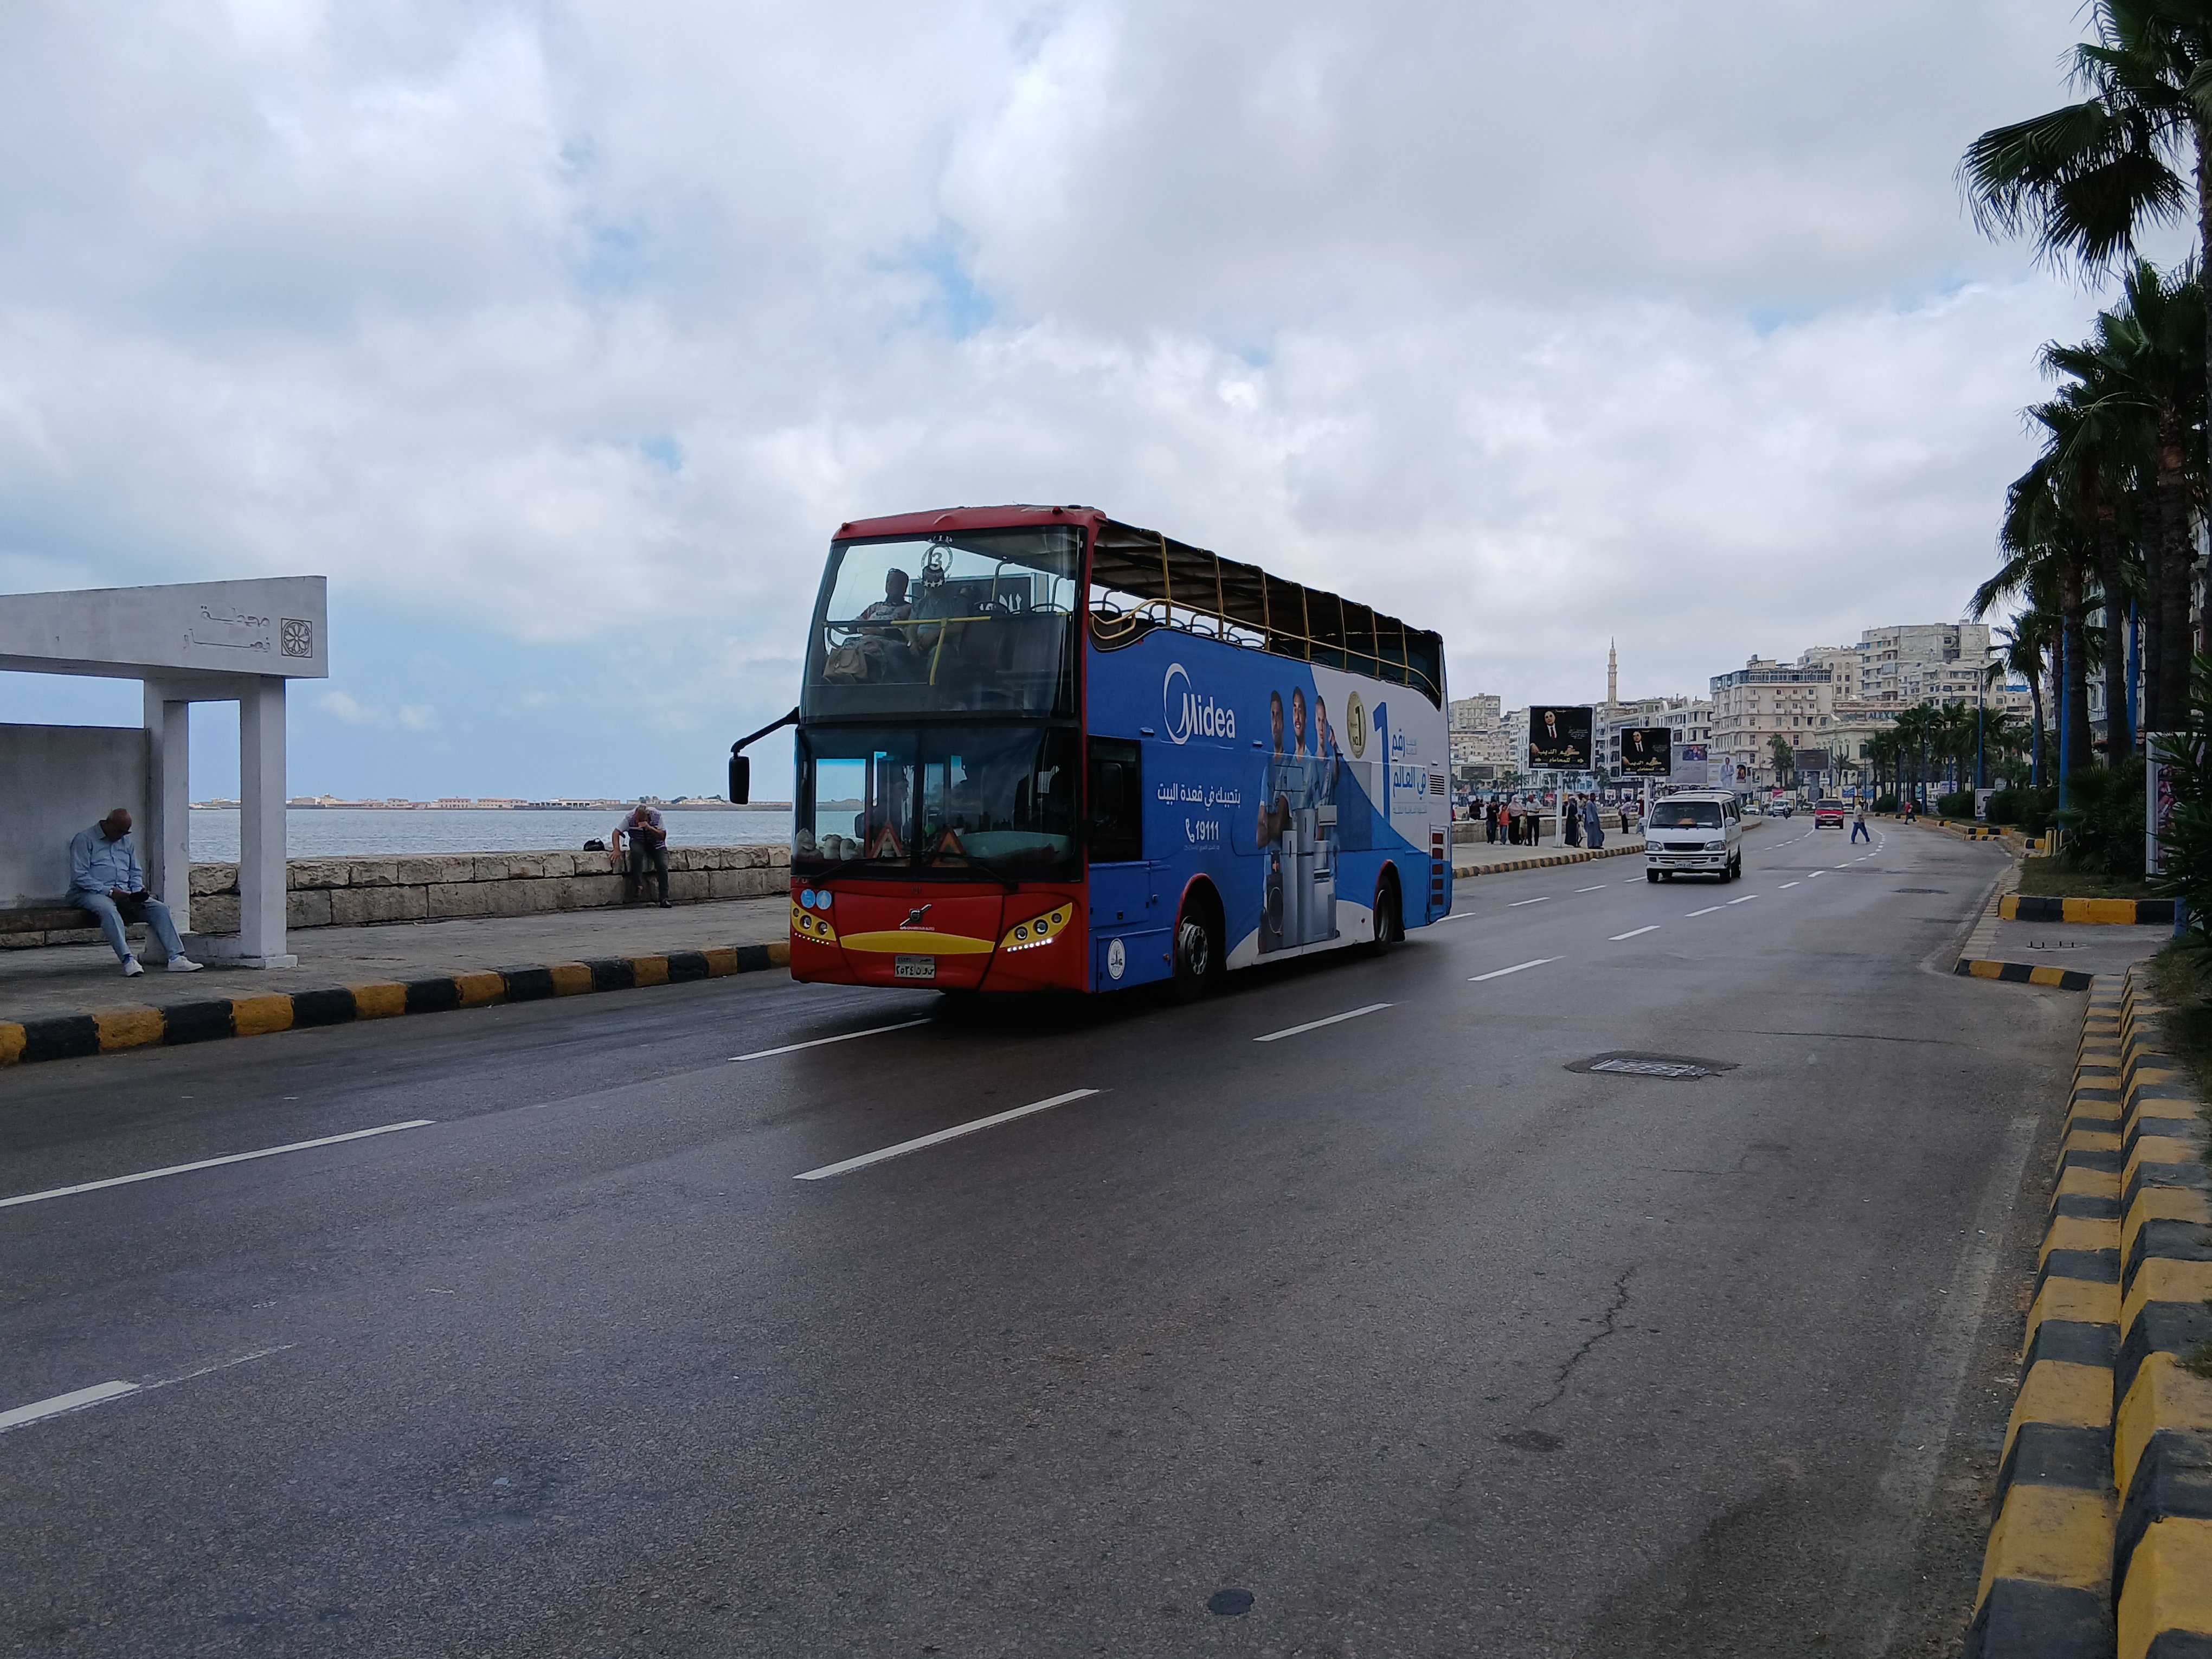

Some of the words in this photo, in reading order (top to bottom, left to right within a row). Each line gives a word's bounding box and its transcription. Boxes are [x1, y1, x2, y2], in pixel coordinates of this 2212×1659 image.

[1164, 692, 1236, 745] Midea
[1392, 728, 1405, 757] رقم
[1158, 783, 1178, 806] البيت
[1180, 784, 1203, 802] قعدة
[1393, 766, 1416, 798] العالم
[1417, 767, 1426, 800] في
[1204, 786, 1214, 812] في
[1195, 820, 1219, 840] 19111
